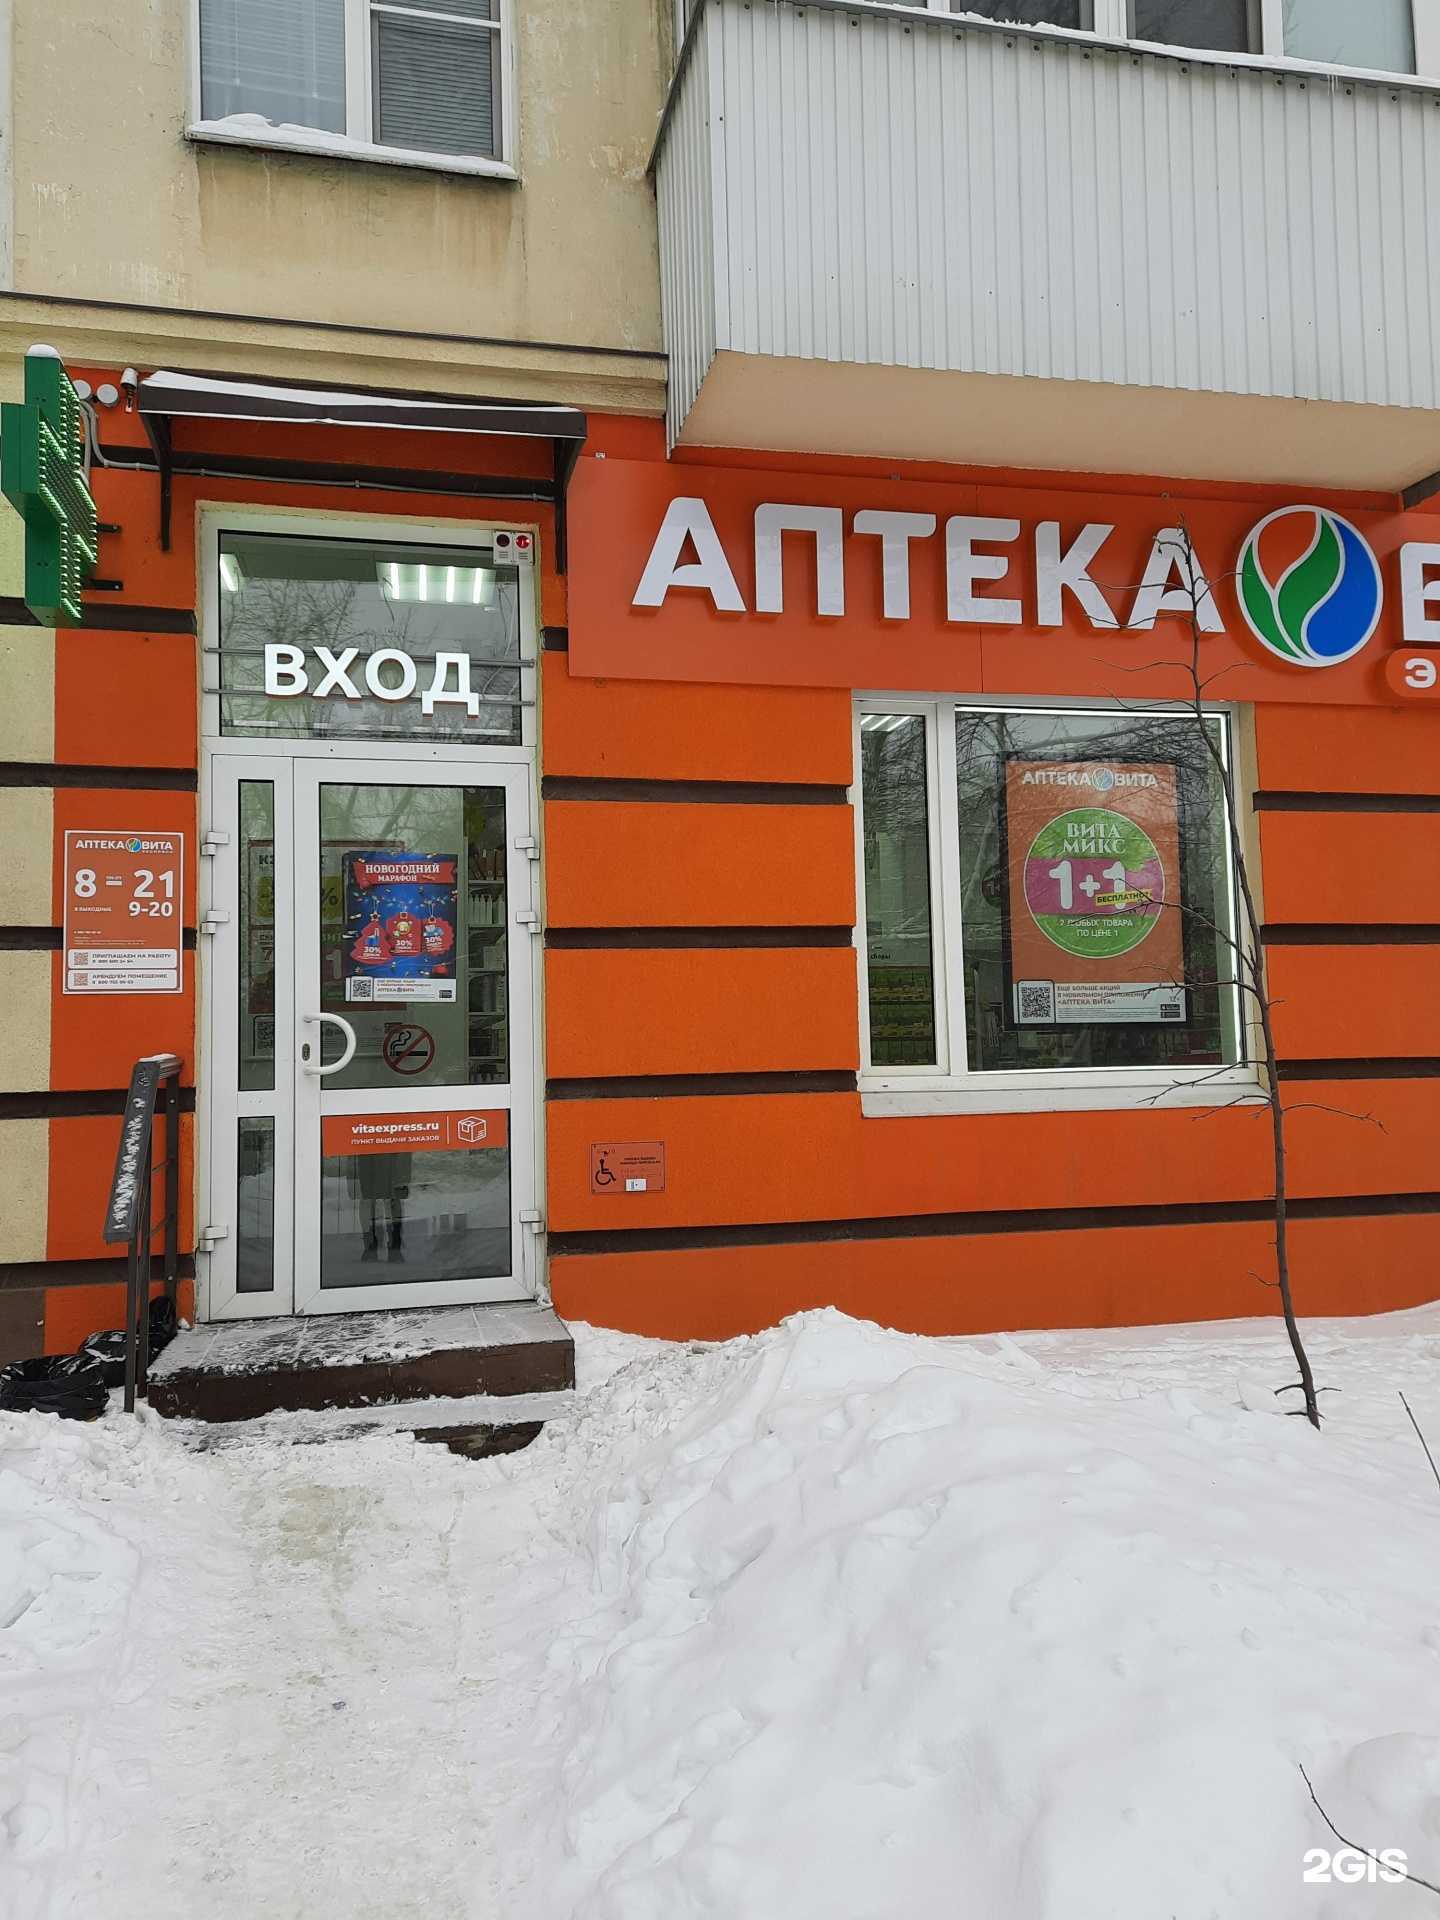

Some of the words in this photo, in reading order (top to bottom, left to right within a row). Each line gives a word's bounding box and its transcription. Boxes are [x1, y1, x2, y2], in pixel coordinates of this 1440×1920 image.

[631, 496, 1226, 633] АПТЕКА
[264, 643, 479, 715] ВХОД
[1021, 771, 1092, 786] АПТЕКА
[1114, 773, 1158, 787] ВИТА
[1066, 823, 1121, 838] ВИТА
[75, 839, 126, 849] АПТЕКА
[142, 841, 173, 850] ВИТА
[1062, 838, 1126, 854] МИКС
[365, 863, 440, 874] НОВОГОДНИЙ
[75, 869, 96, 897] 8
[133, 869, 173, 897] 21
[129, 901, 173, 917] 9-20
[1103, 919, 1133, 927] ТОВАРА
[1091, 930, 1112, 938] ЦЕНЕ
[351, 1121, 439, 1134] vitaexpress.ru
[375, 1137, 406, 1145] ВЫДАЧИ
[407, 1135, 440, 1143] ЗАКАЗОВ
